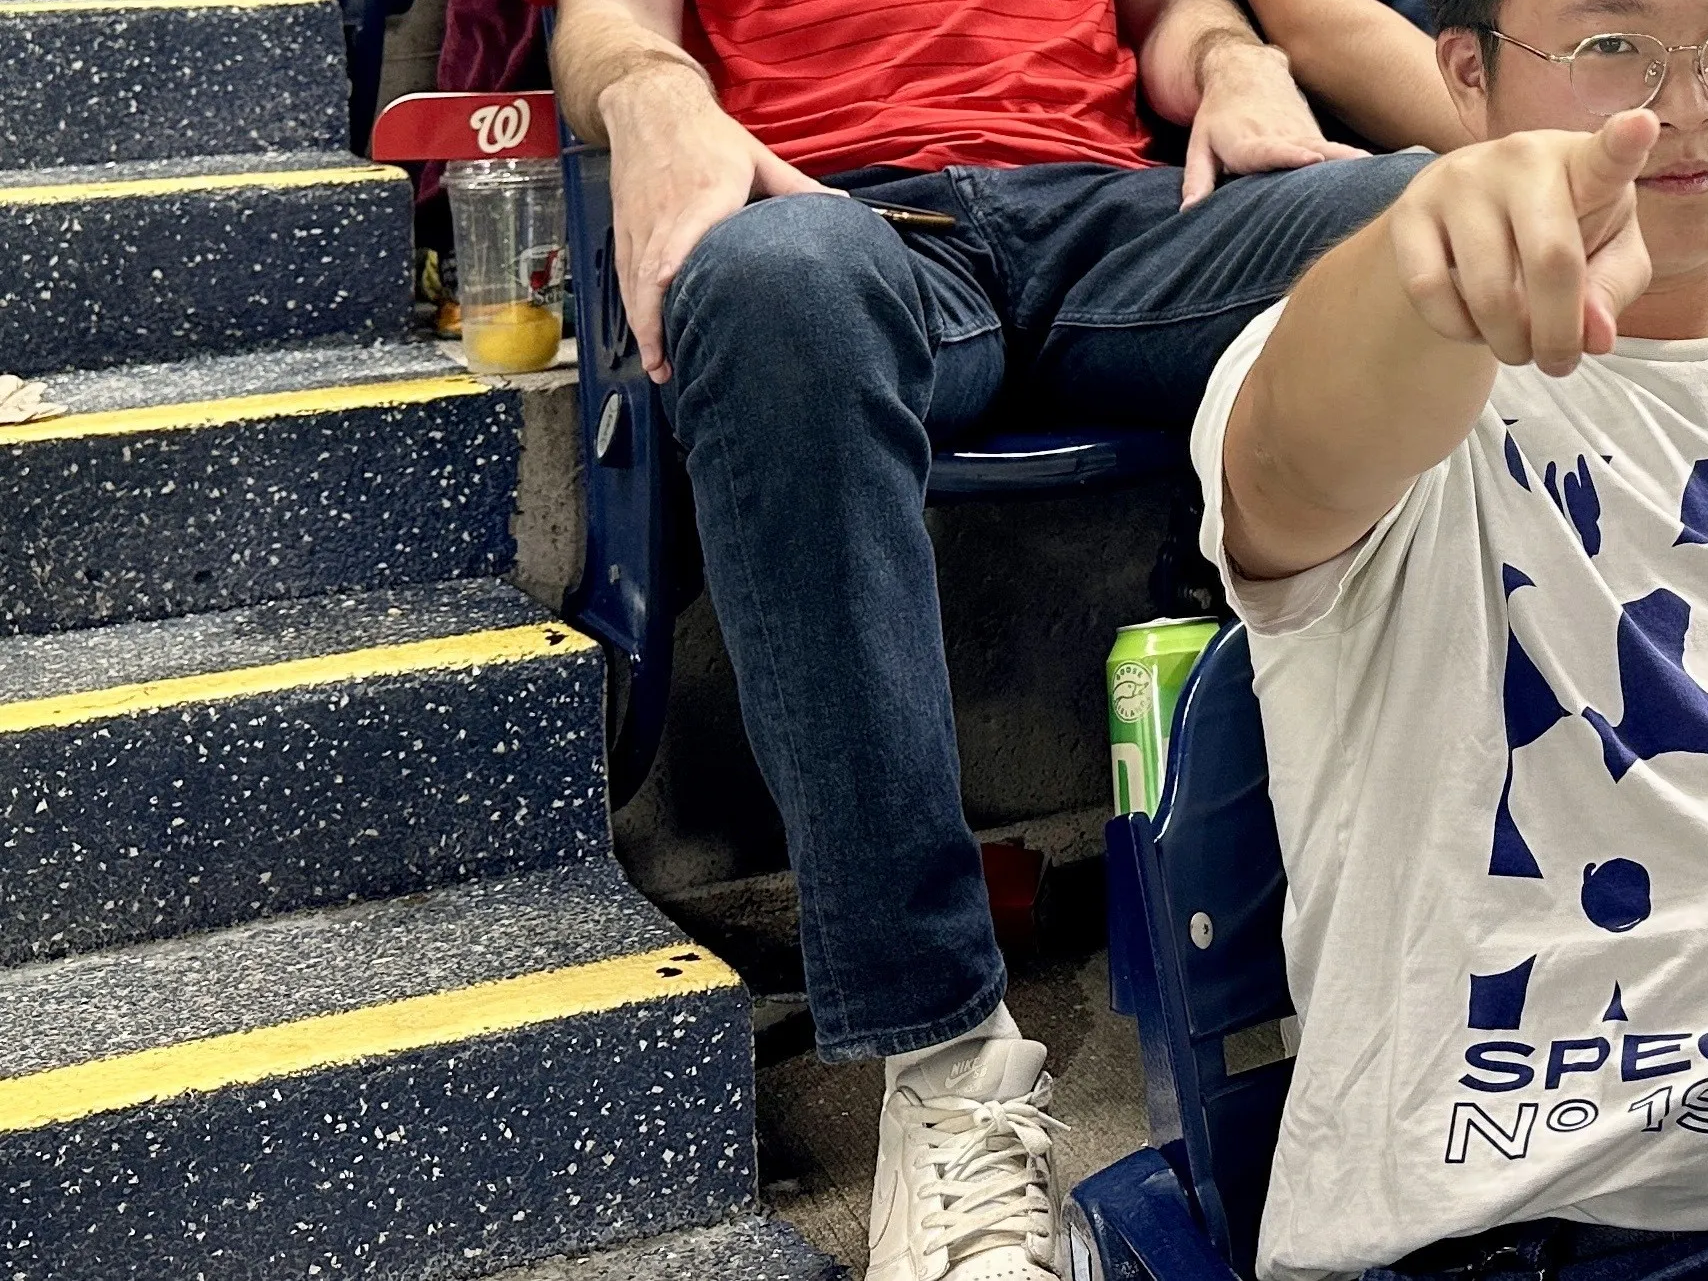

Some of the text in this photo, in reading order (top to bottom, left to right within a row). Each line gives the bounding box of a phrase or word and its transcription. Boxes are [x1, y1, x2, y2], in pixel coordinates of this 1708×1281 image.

[469, 98, 532, 154] W
[1115, 665, 1145, 682] GOOSE
[949, 1055, 982, 1078] NIKE
